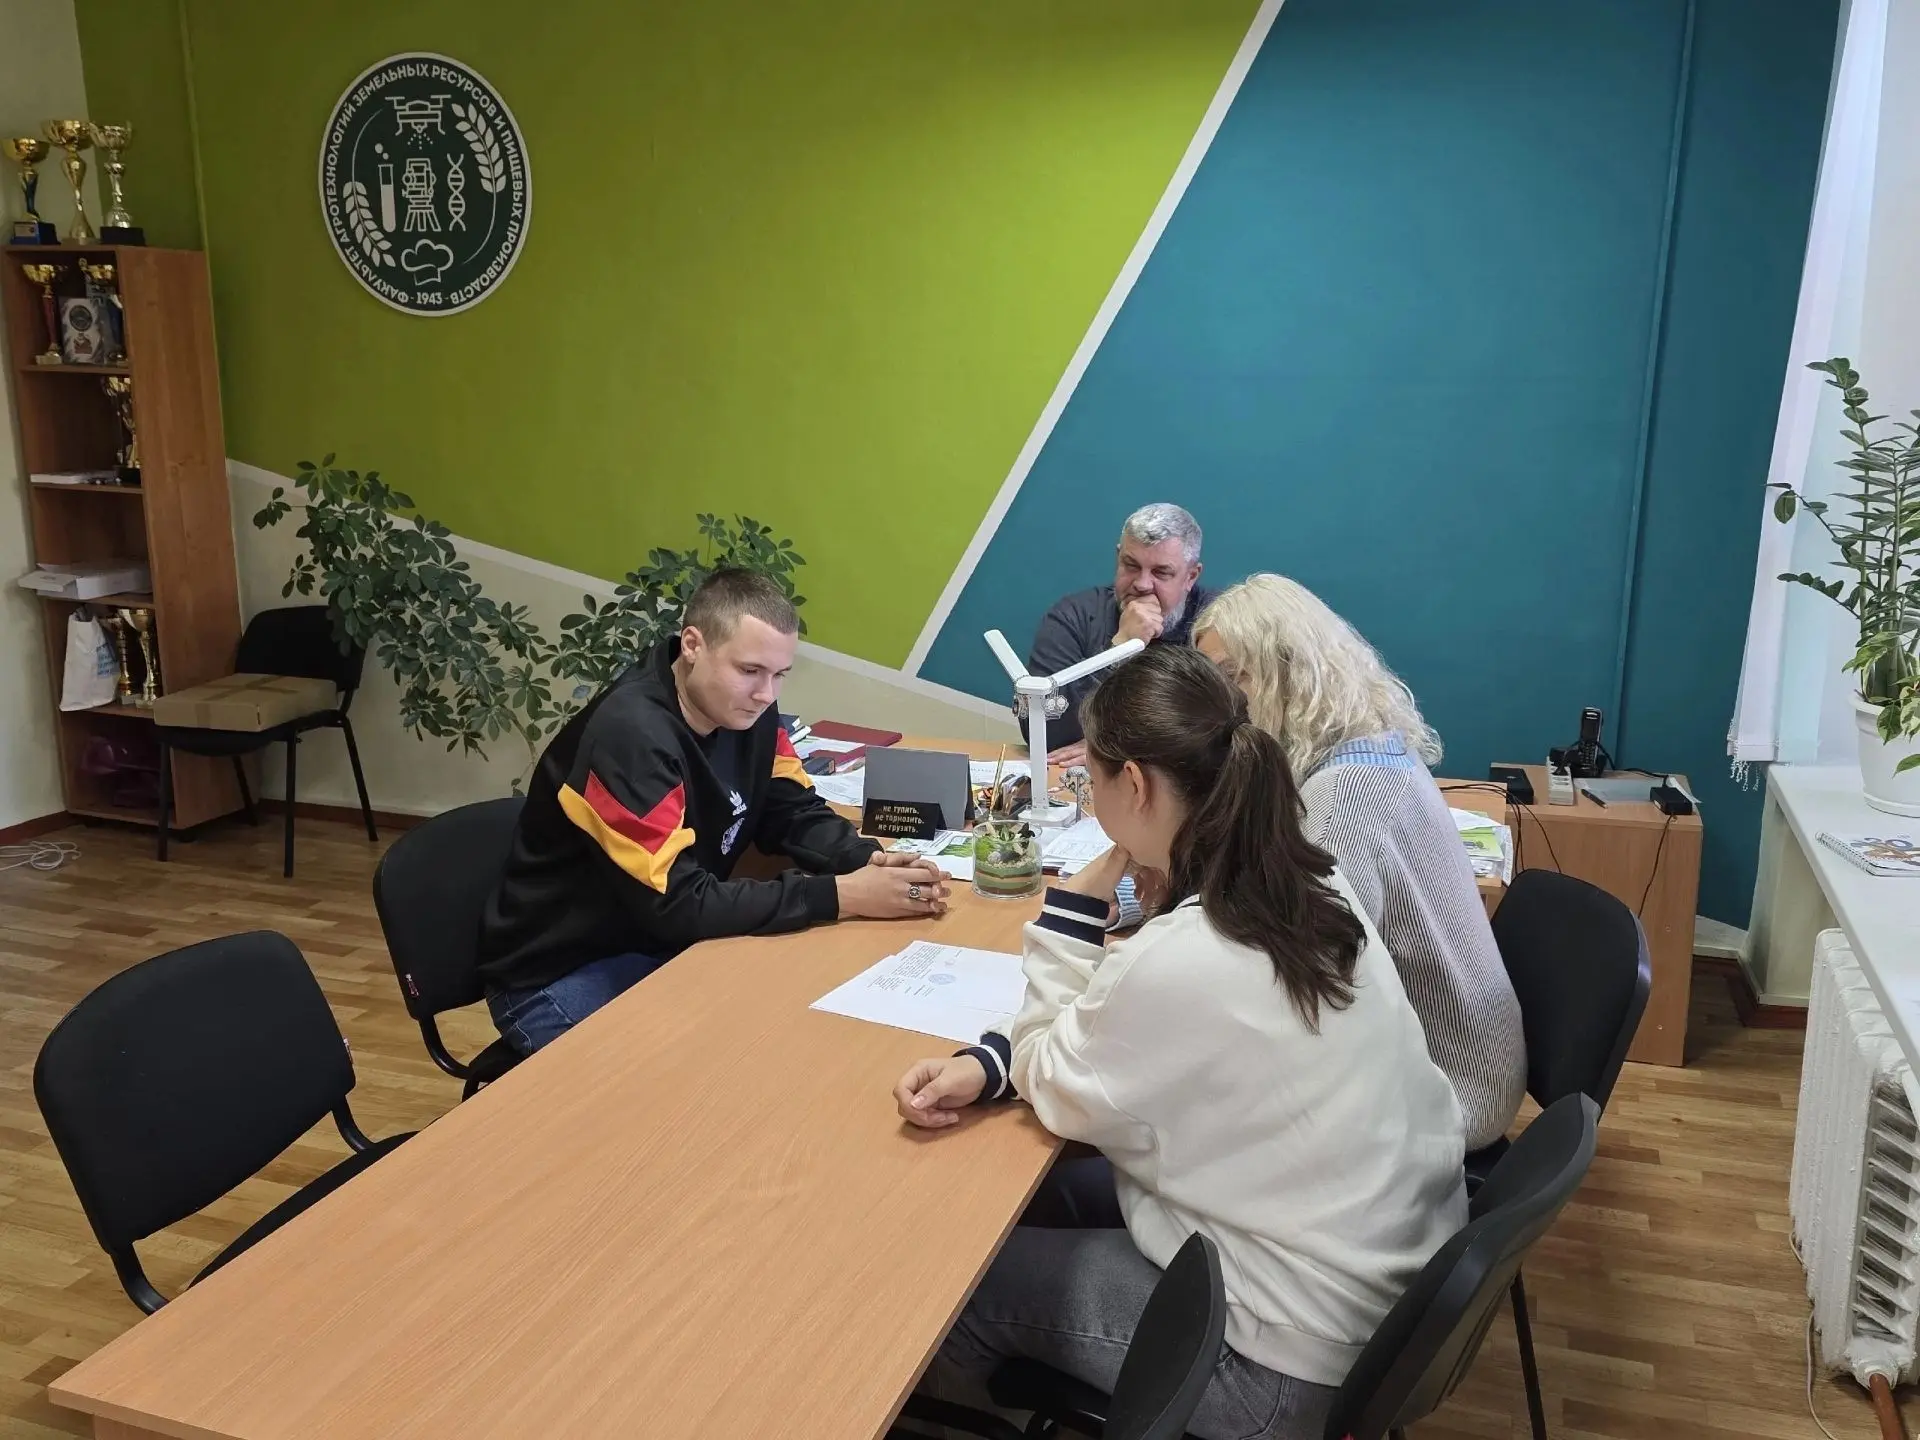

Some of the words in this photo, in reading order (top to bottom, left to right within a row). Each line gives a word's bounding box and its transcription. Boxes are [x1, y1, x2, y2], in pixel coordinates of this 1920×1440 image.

[352, 63, 430, 107] ЗЕМЕЛЬНЫХ
[431, 65, 497, 117] РЕСУРСОВ
[495, 115, 505, 128] И
[326, 102, 355, 243] АГРОТЕХНОЛОГИЙ
[502, 127, 524, 220] ПИЩЕВЫХ
[346, 244, 410, 304] ФАКУЛЬТЕТ
[450, 221, 520, 305] ПРОИЗВОДСТВ
[416, 292, 443, 304] 1943
